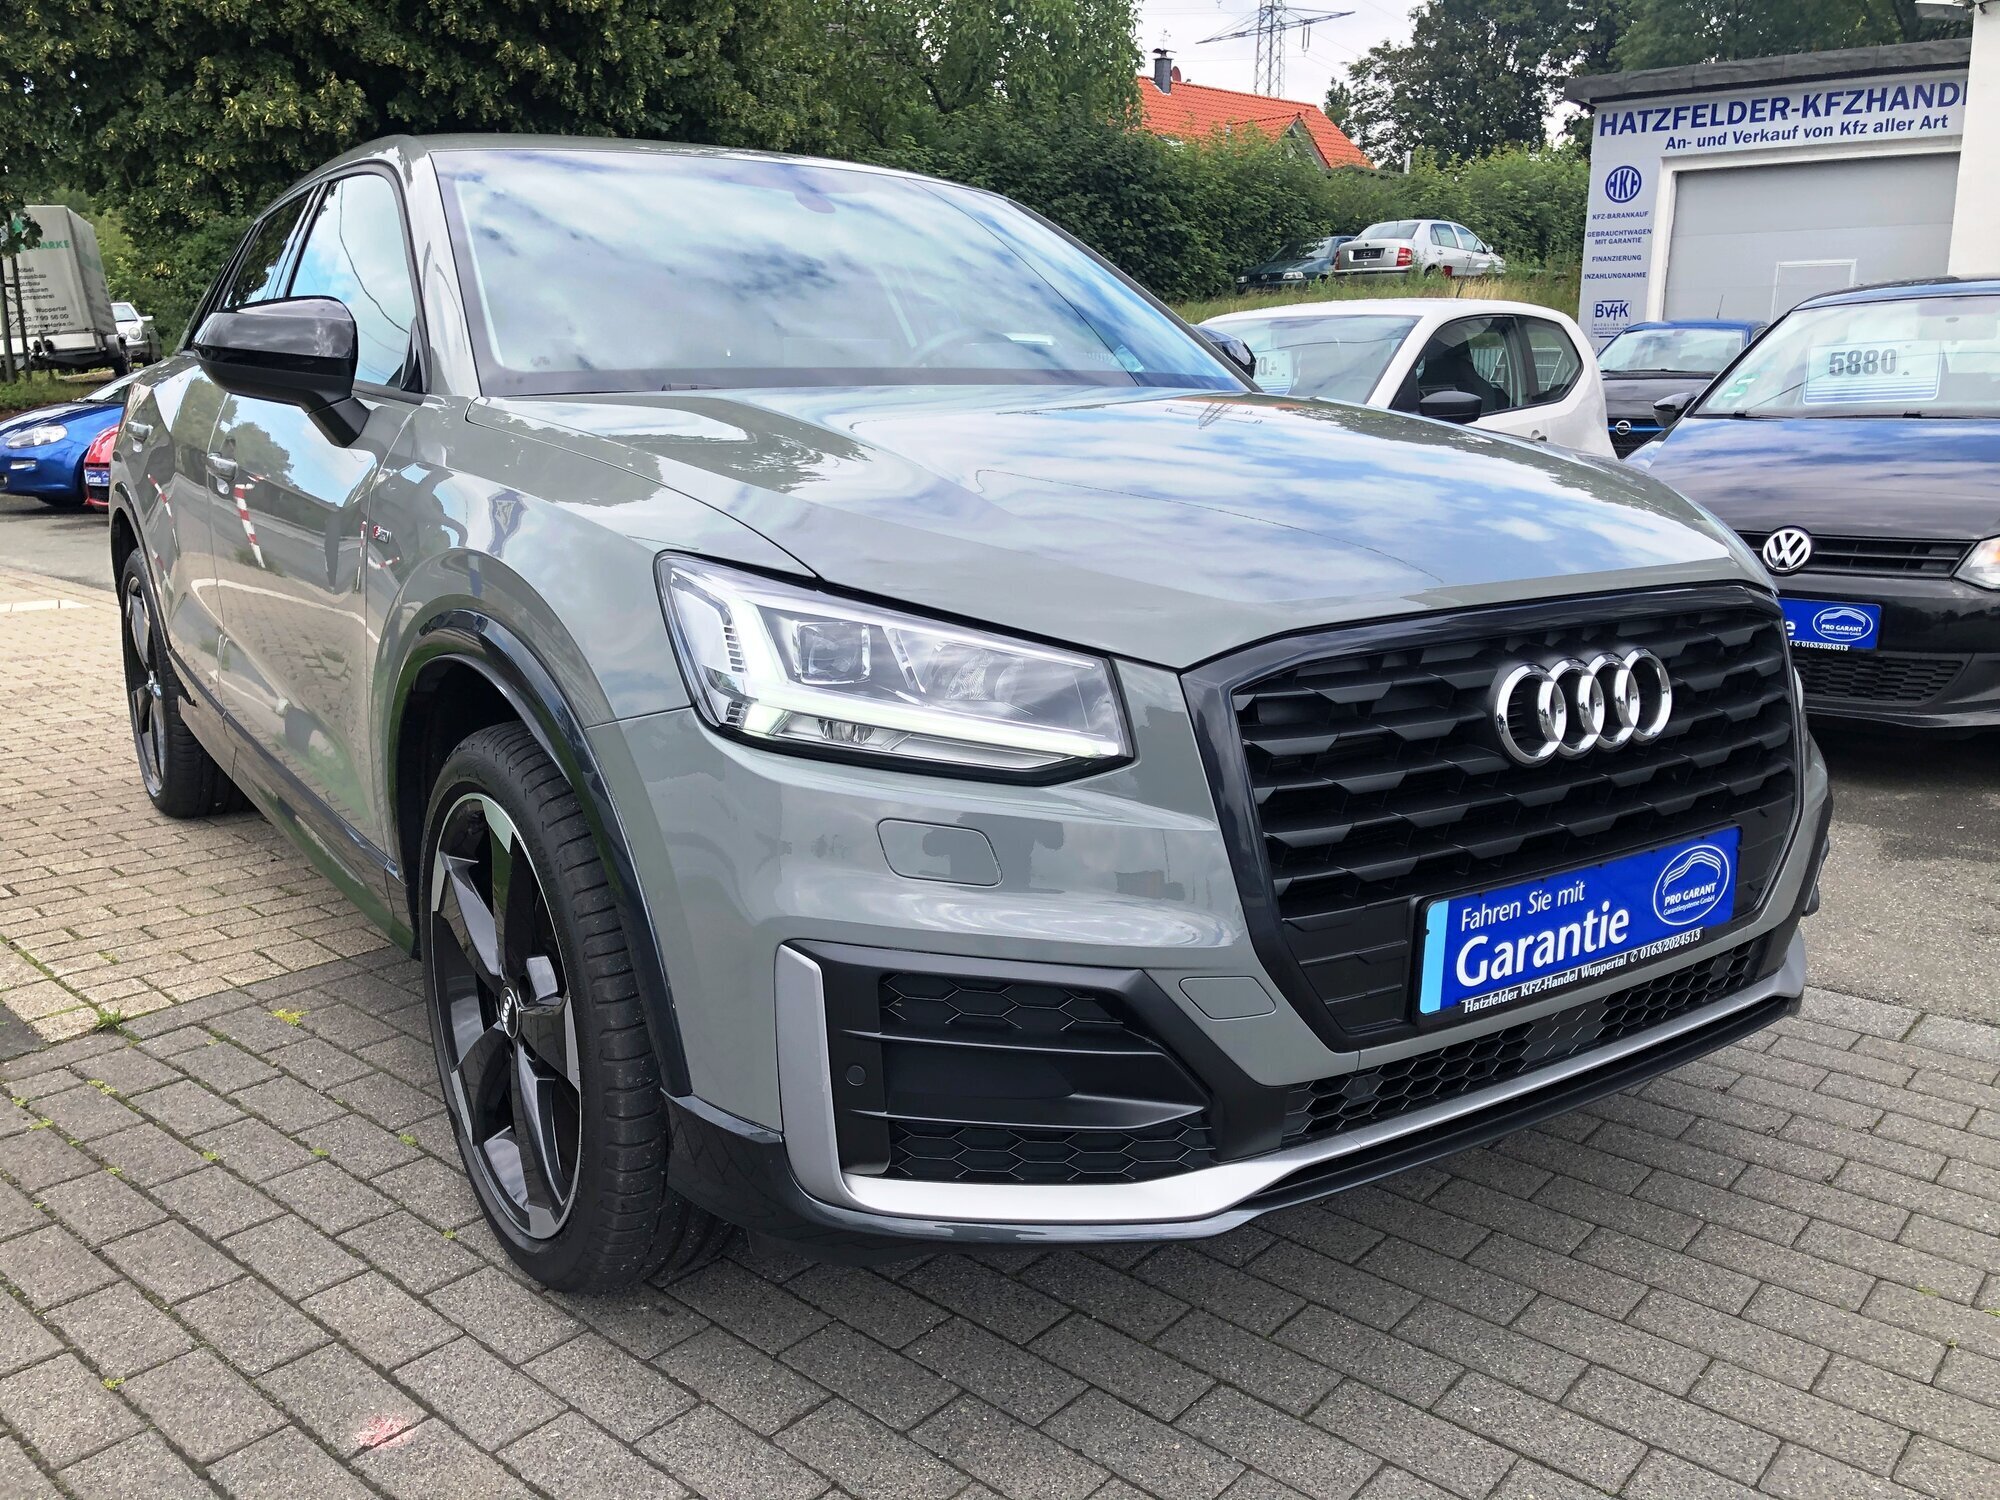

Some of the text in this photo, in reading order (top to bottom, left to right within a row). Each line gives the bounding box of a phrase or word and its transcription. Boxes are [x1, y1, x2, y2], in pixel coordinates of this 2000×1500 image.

[1665, 114, 1948, 150] An- und Verkauf von Kfz aller Art
[1592, 210, 1649, 220] KFZ-BARANKAUF
[1587, 228, 1653, 238] GEBRAUCHTWAGEN
[38, 240, 70, 250] ARKE
[1592, 254, 1642, 262] FINANZIERUNG
[1584, 271, 1647, 279] INZAHLUNGNAHME
[1828, 349, 1897, 376] 5880
[1821, 623, 1835, 631] PRO
[1664, 882, 1717, 907] PRO GARANT
[1461, 880, 1586, 932] Fahren Sie mit
[1456, 900, 1630, 988] Garantie
[1463, 989, 1519, 1014] Hatzfelder
[1520, 966, 1579, 997] KFZ-Handel
[1581, 953, 1628, 979] Wuppertal
